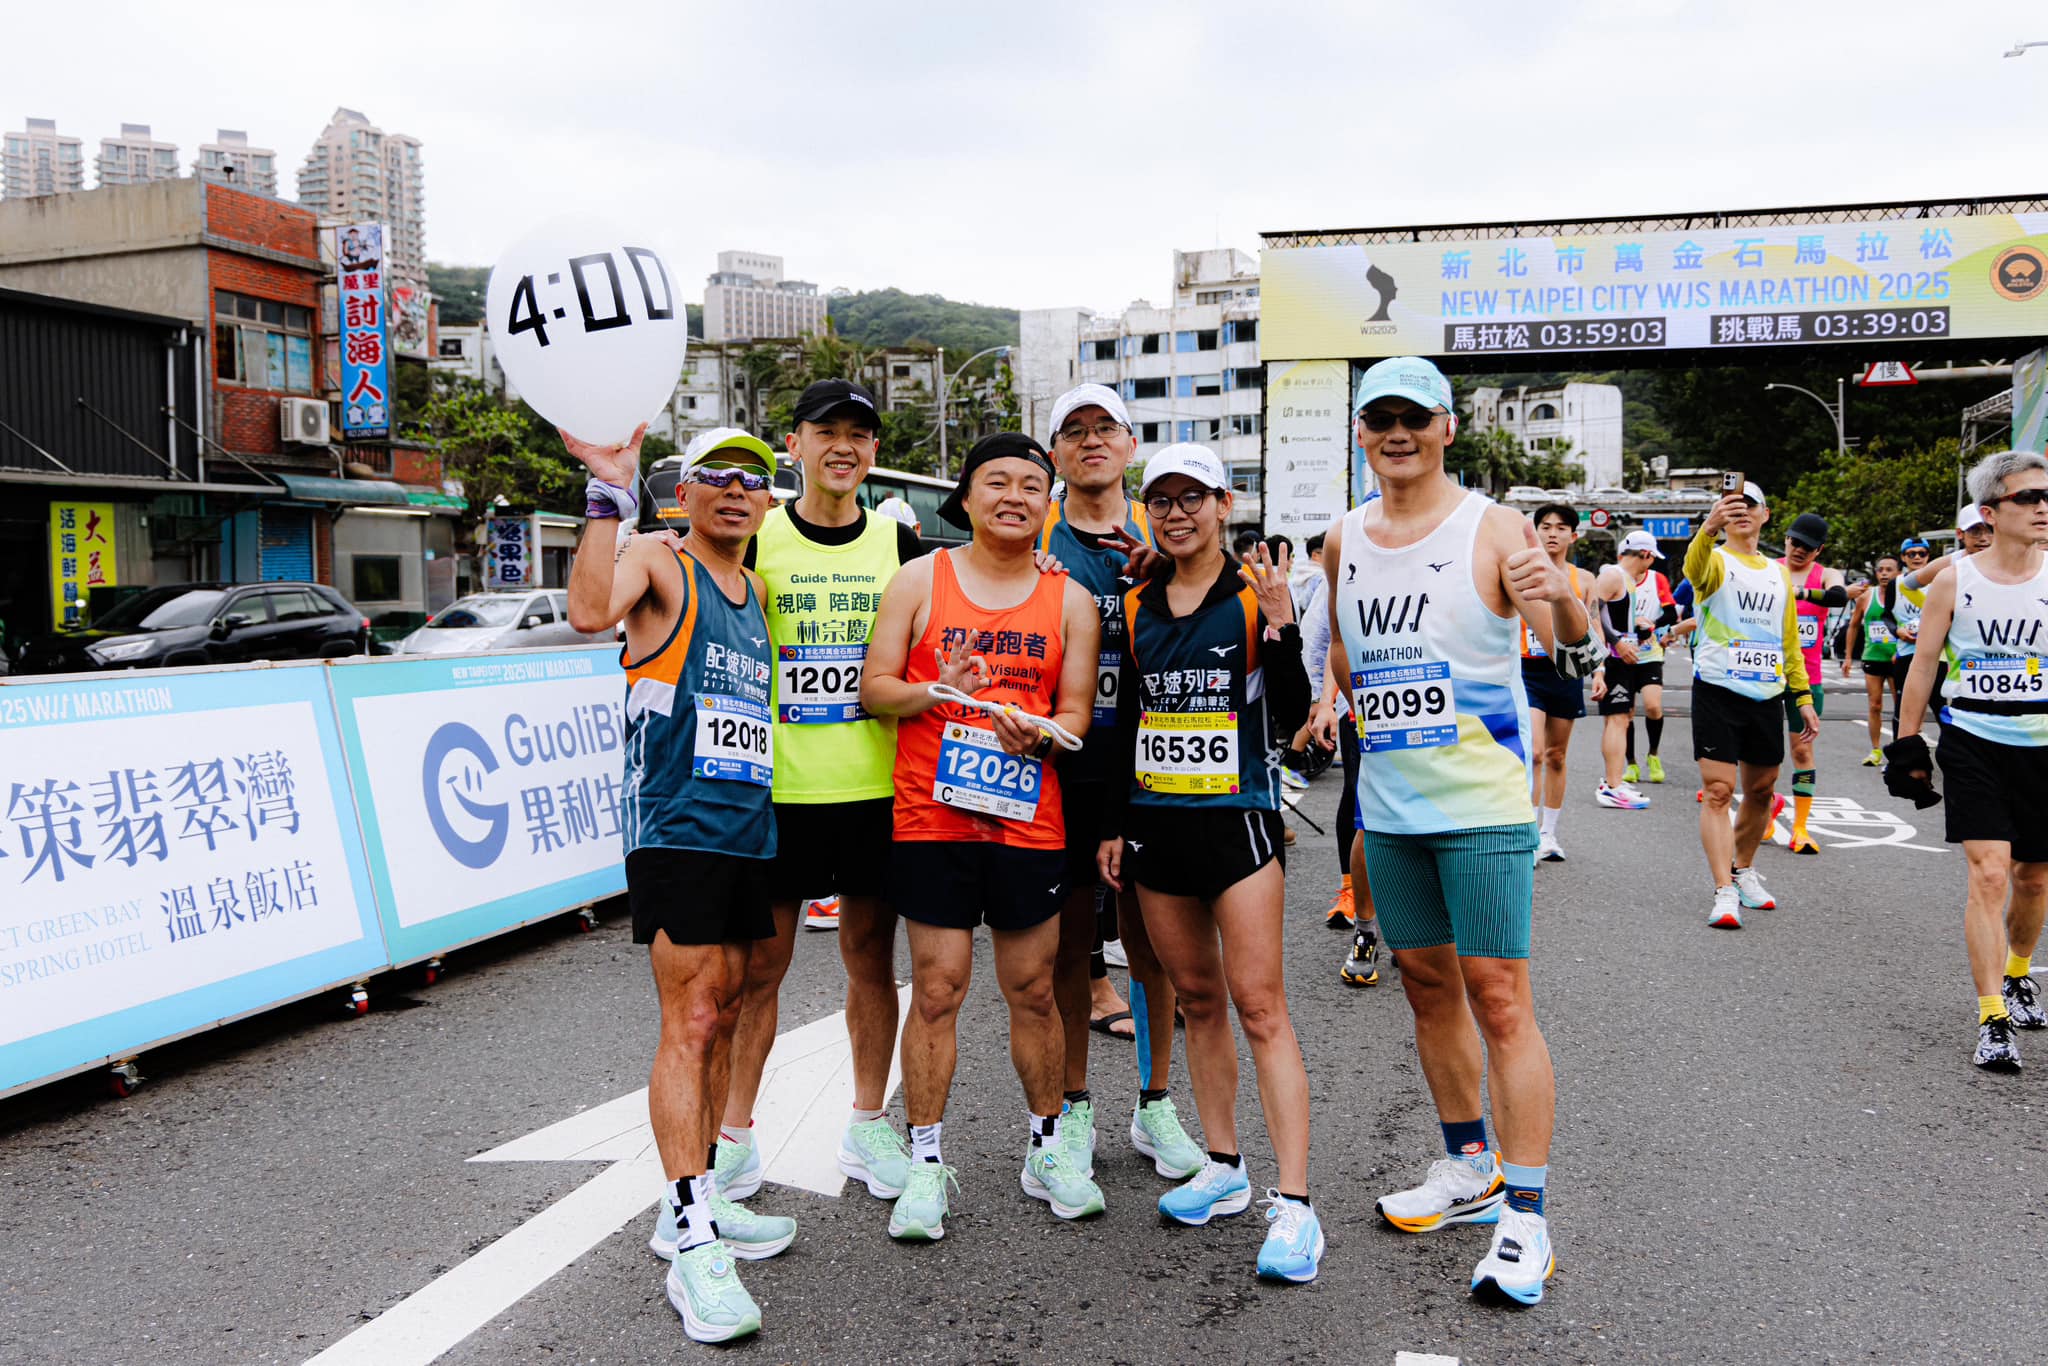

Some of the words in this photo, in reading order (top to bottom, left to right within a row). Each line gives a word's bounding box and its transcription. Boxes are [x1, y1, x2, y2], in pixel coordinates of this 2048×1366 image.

[1441, 228, 1953, 280] 新北市萬金石馬拉松
[343, 274, 379, 289] 萬里
[508, 246, 674, 347] 4:00
[1441, 289, 1498, 317] NEW
[1506, 286, 1585, 315] TAIPEI
[1592, 284, 1649, 313] CITY
[1657, 281, 1711, 310] WJS
[1719, 274, 1869, 307] MARATHON
[1879, 271, 1951, 302] 2025
[1452, 323, 1530, 351] 馬拉松
[1540, 319, 1664, 346] 03:59:03
[1718, 315, 1802, 343] 挑戰馬
[1814, 310, 1946, 337] 03:39:03
[346, 294, 383, 402] 討海人
[791, 574, 828, 584] Guide
[832, 573, 876, 583] Runner
[776, 593, 817, 614] 視障
[503, 664, 526, 681] 2025
[545, 658, 592, 677] MARATHON
[706, 641, 770, 685] 配速列車
[1362, 647, 1423, 664] MARATHON
[1735, 651, 1778, 668] 14618
[786, 666, 864, 693] 1202
[990, 664, 1043, 682] Visually
[999, 679, 1039, 692] Runner
[1966, 674, 2043, 694] 10845
[73, 687, 174, 718] MARATHON
[1358, 686, 1446, 721] 12099
[708, 717, 767, 756] 12018
[1141, 734, 1229, 763] 16536
[946, 746, 1037, 793] 12026
[942, 786, 953, 802] C
[0, 748, 301, 885] 策翡翠灣
[520, 772, 622, 855] 果利生
[159, 859, 319, 944] 溫泉飯店
[28, 907, 99, 944] GREEN
[103, 898, 143, 927] BAY
[0, 948, 81, 988] SPRING
[85, 931, 153, 966] HOTEL
